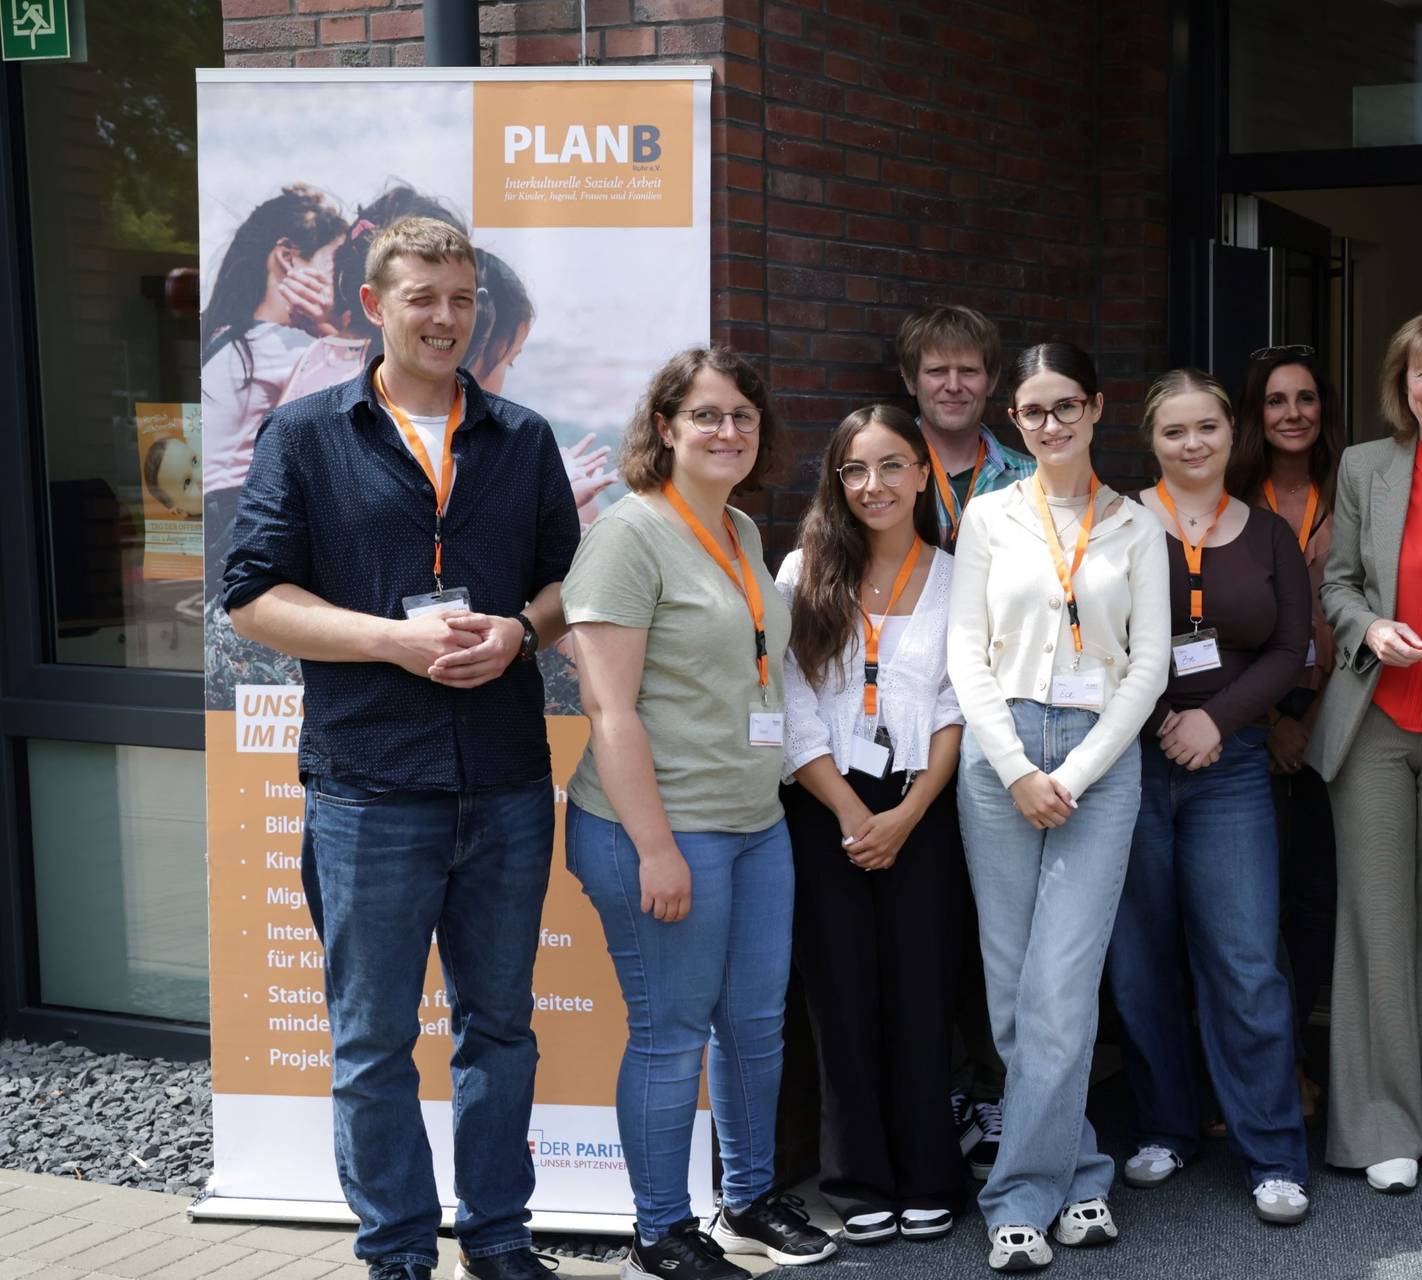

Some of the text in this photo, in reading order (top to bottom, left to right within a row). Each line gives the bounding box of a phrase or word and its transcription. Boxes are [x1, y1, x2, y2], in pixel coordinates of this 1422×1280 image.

[504, 124, 662, 164] PLANB
[504, 175, 662, 189] Interkulturelle Soziale Arbeit
[580, 191, 608, 200] Frauen
[610, 191, 625, 200] und
[628, 191, 662, 200] Familien
[243, 725, 275, 747] IM
[267, 949, 295, 968] für
[539, 1141, 572, 1156] DER
[540, 1159, 572, 1168] UNSER
